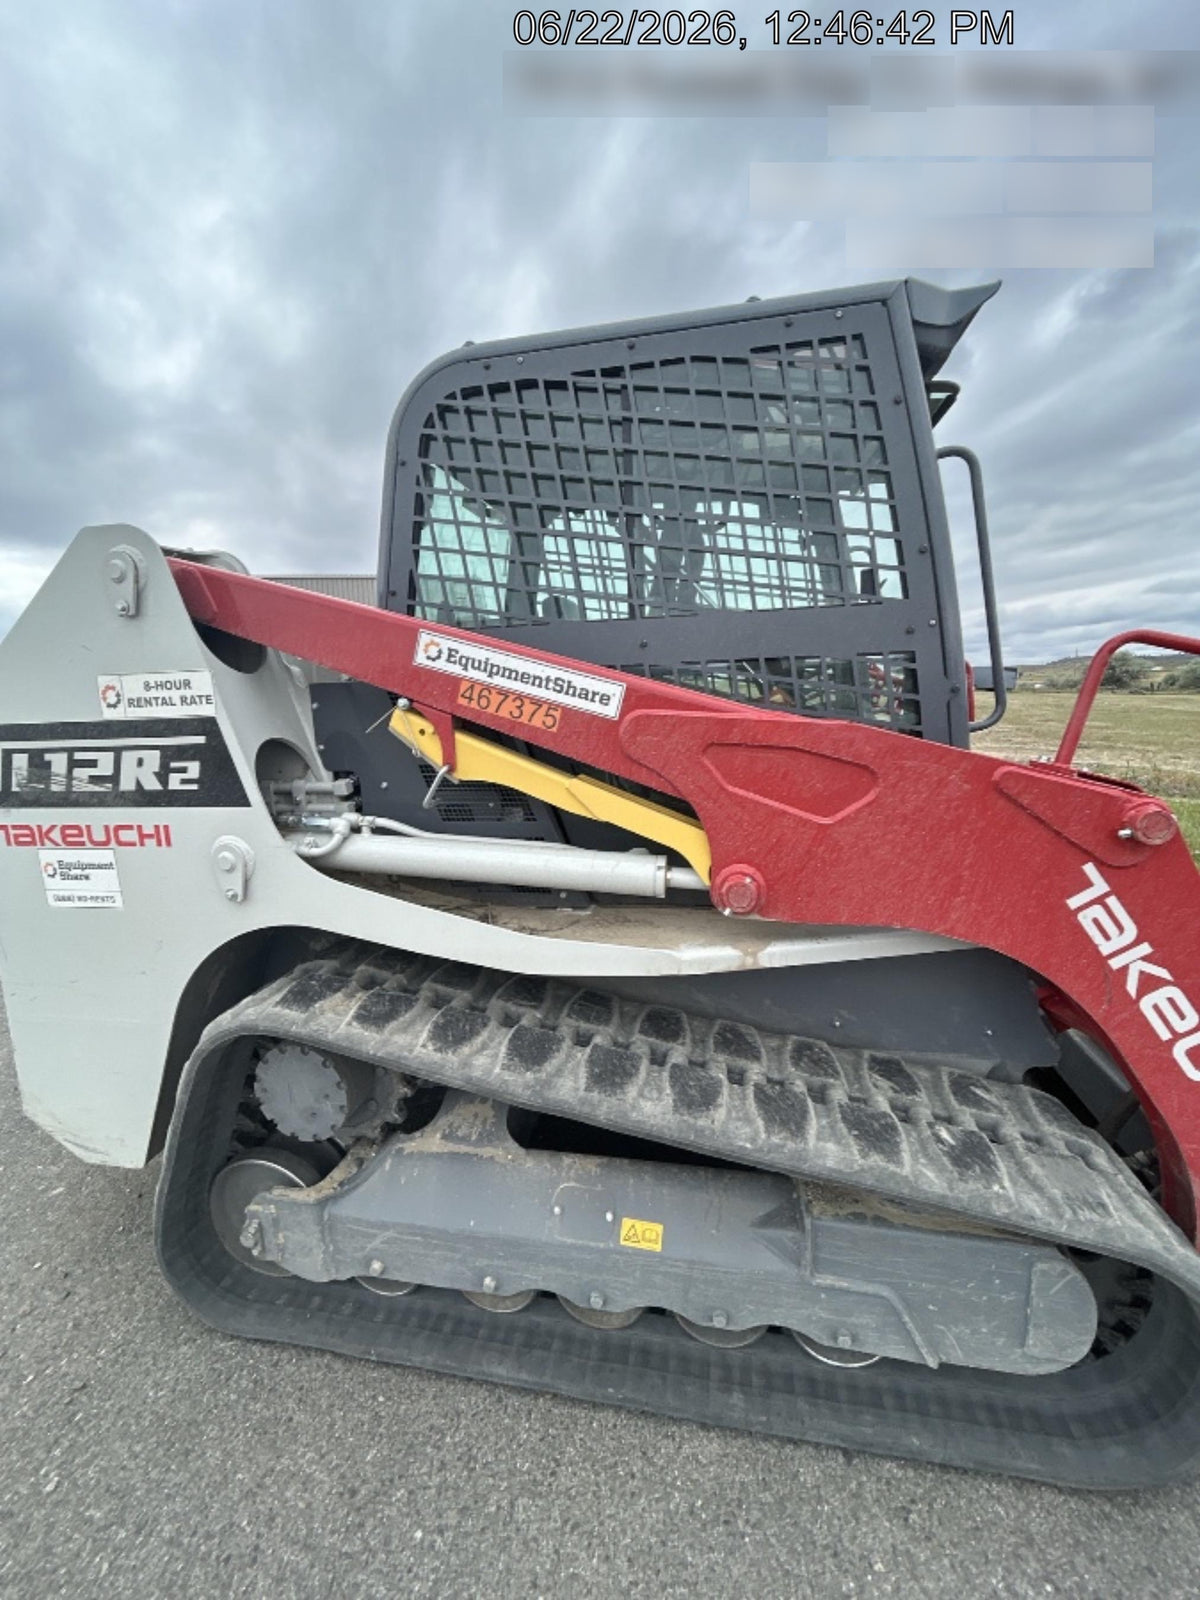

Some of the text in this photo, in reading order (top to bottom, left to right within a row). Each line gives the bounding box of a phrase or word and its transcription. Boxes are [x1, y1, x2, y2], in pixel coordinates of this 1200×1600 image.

[143, 679, 192, 692] 8-HOUR
[445, 647, 611, 706] EquipmentShare
[127, 695, 214, 708] RENTAL RATE
[460, 684, 559, 730] 467375
[0, 750, 200, 792] L12R2
